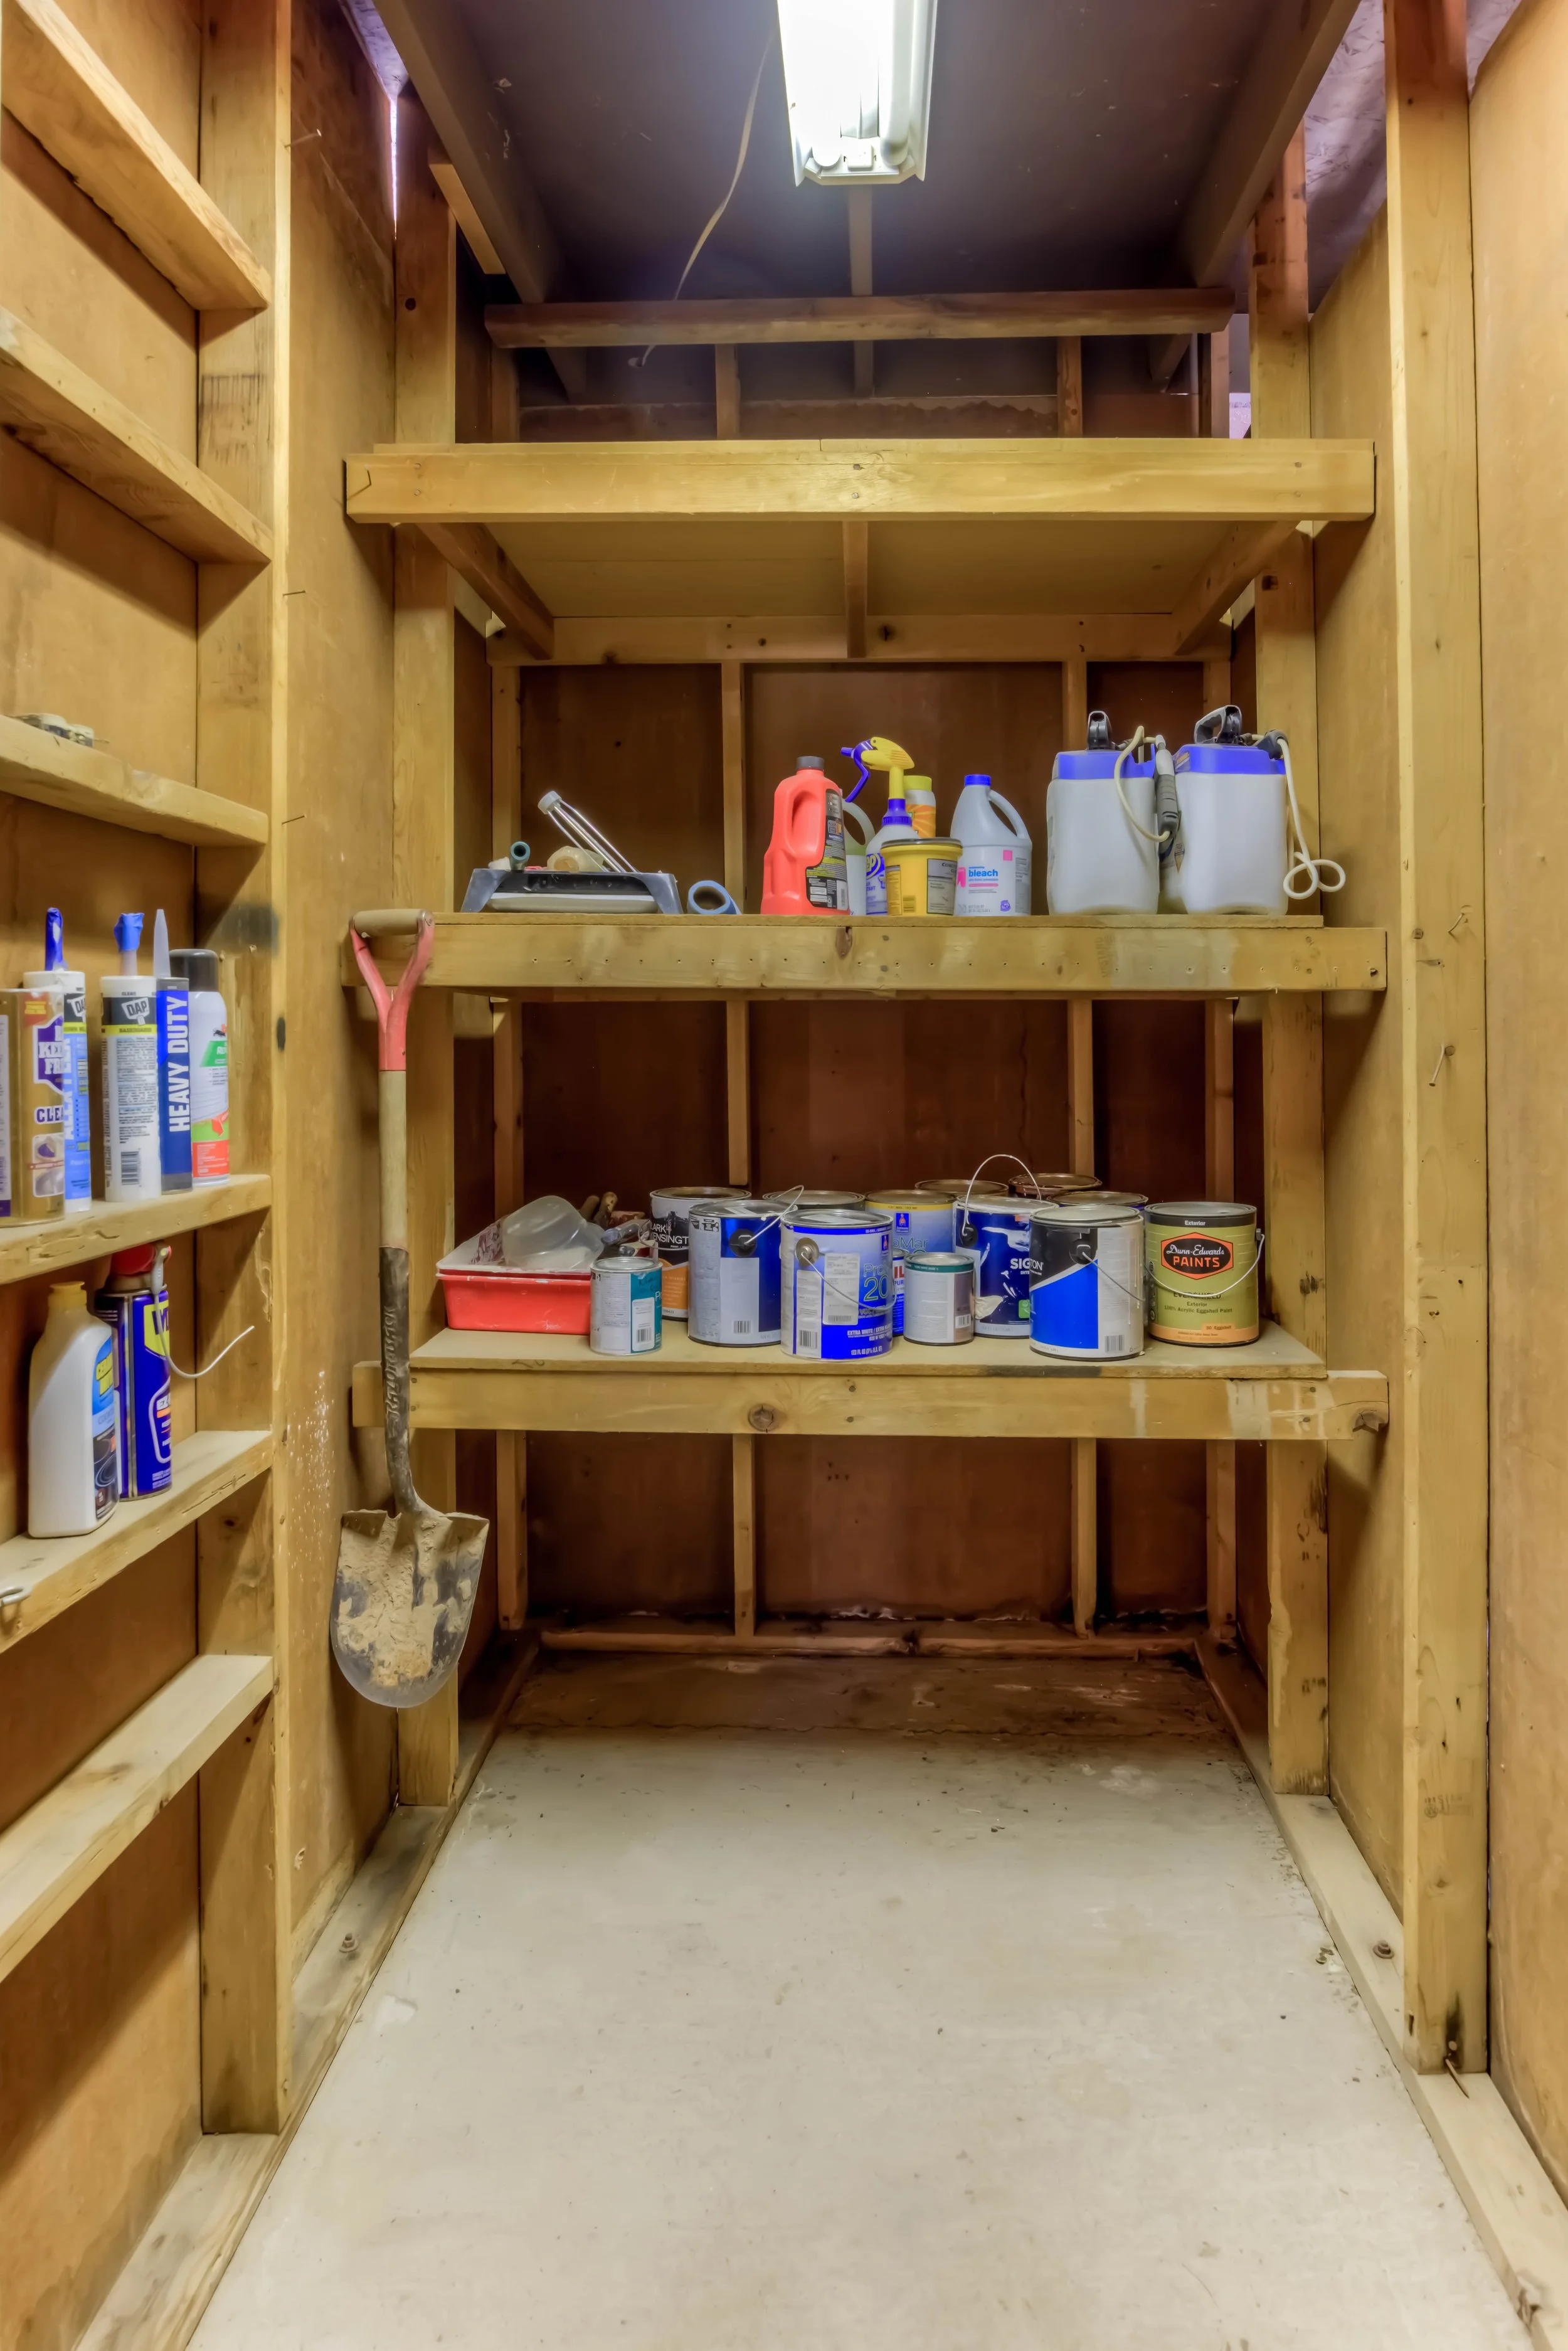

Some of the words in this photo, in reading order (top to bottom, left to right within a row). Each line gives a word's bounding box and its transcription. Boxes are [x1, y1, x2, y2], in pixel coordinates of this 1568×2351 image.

[126, 1000, 147, 1016] DAP
[166, 995, 189, 1054] DUTY
[167, 1062, 191, 1132] HEAVY
[1166, 1244, 1224, 1256] Dunn-Edwards
[1173, 1256, 1220, 1267] PAINTS
